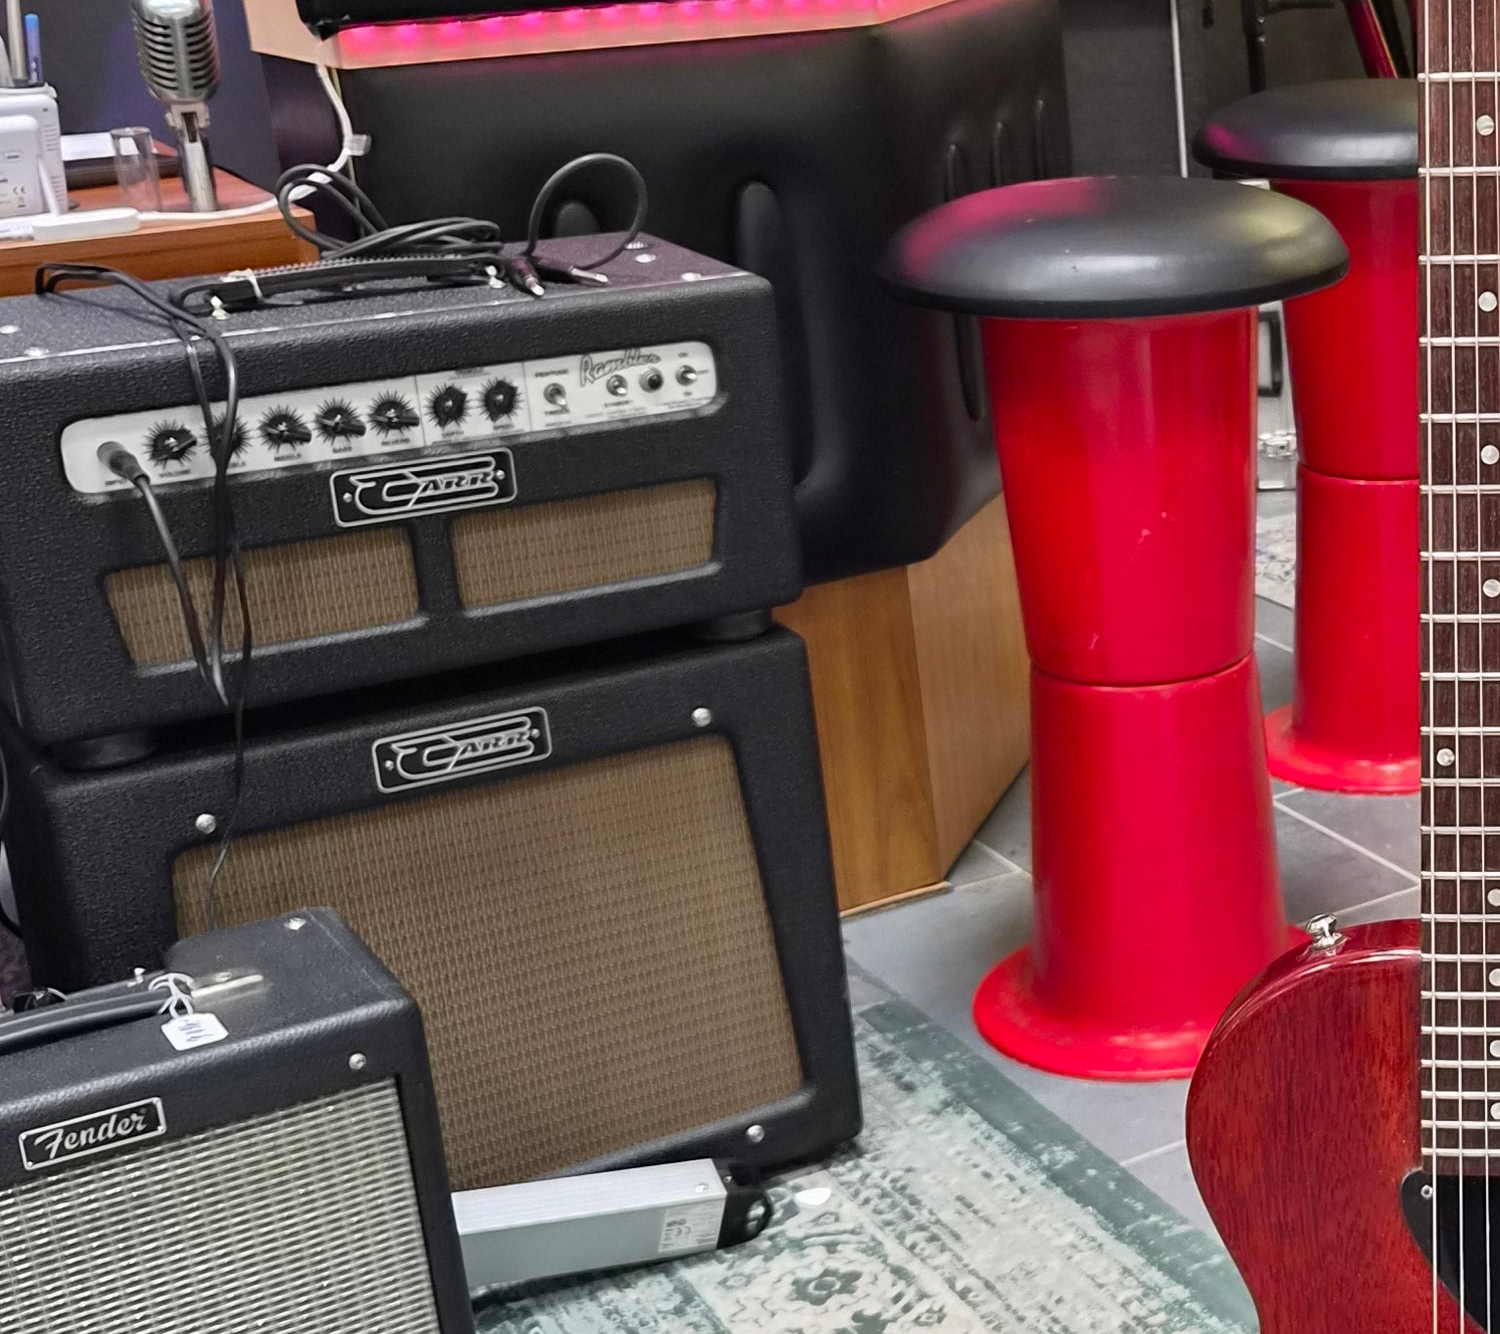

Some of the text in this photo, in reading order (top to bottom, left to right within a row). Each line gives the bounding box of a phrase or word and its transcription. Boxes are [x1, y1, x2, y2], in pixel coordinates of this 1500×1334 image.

[580, 348, 662, 388] Rambler
[350, 456, 499, 515] CARR
[390, 716, 535, 781] CARR
[34, 1113, 147, 1159] Fender
